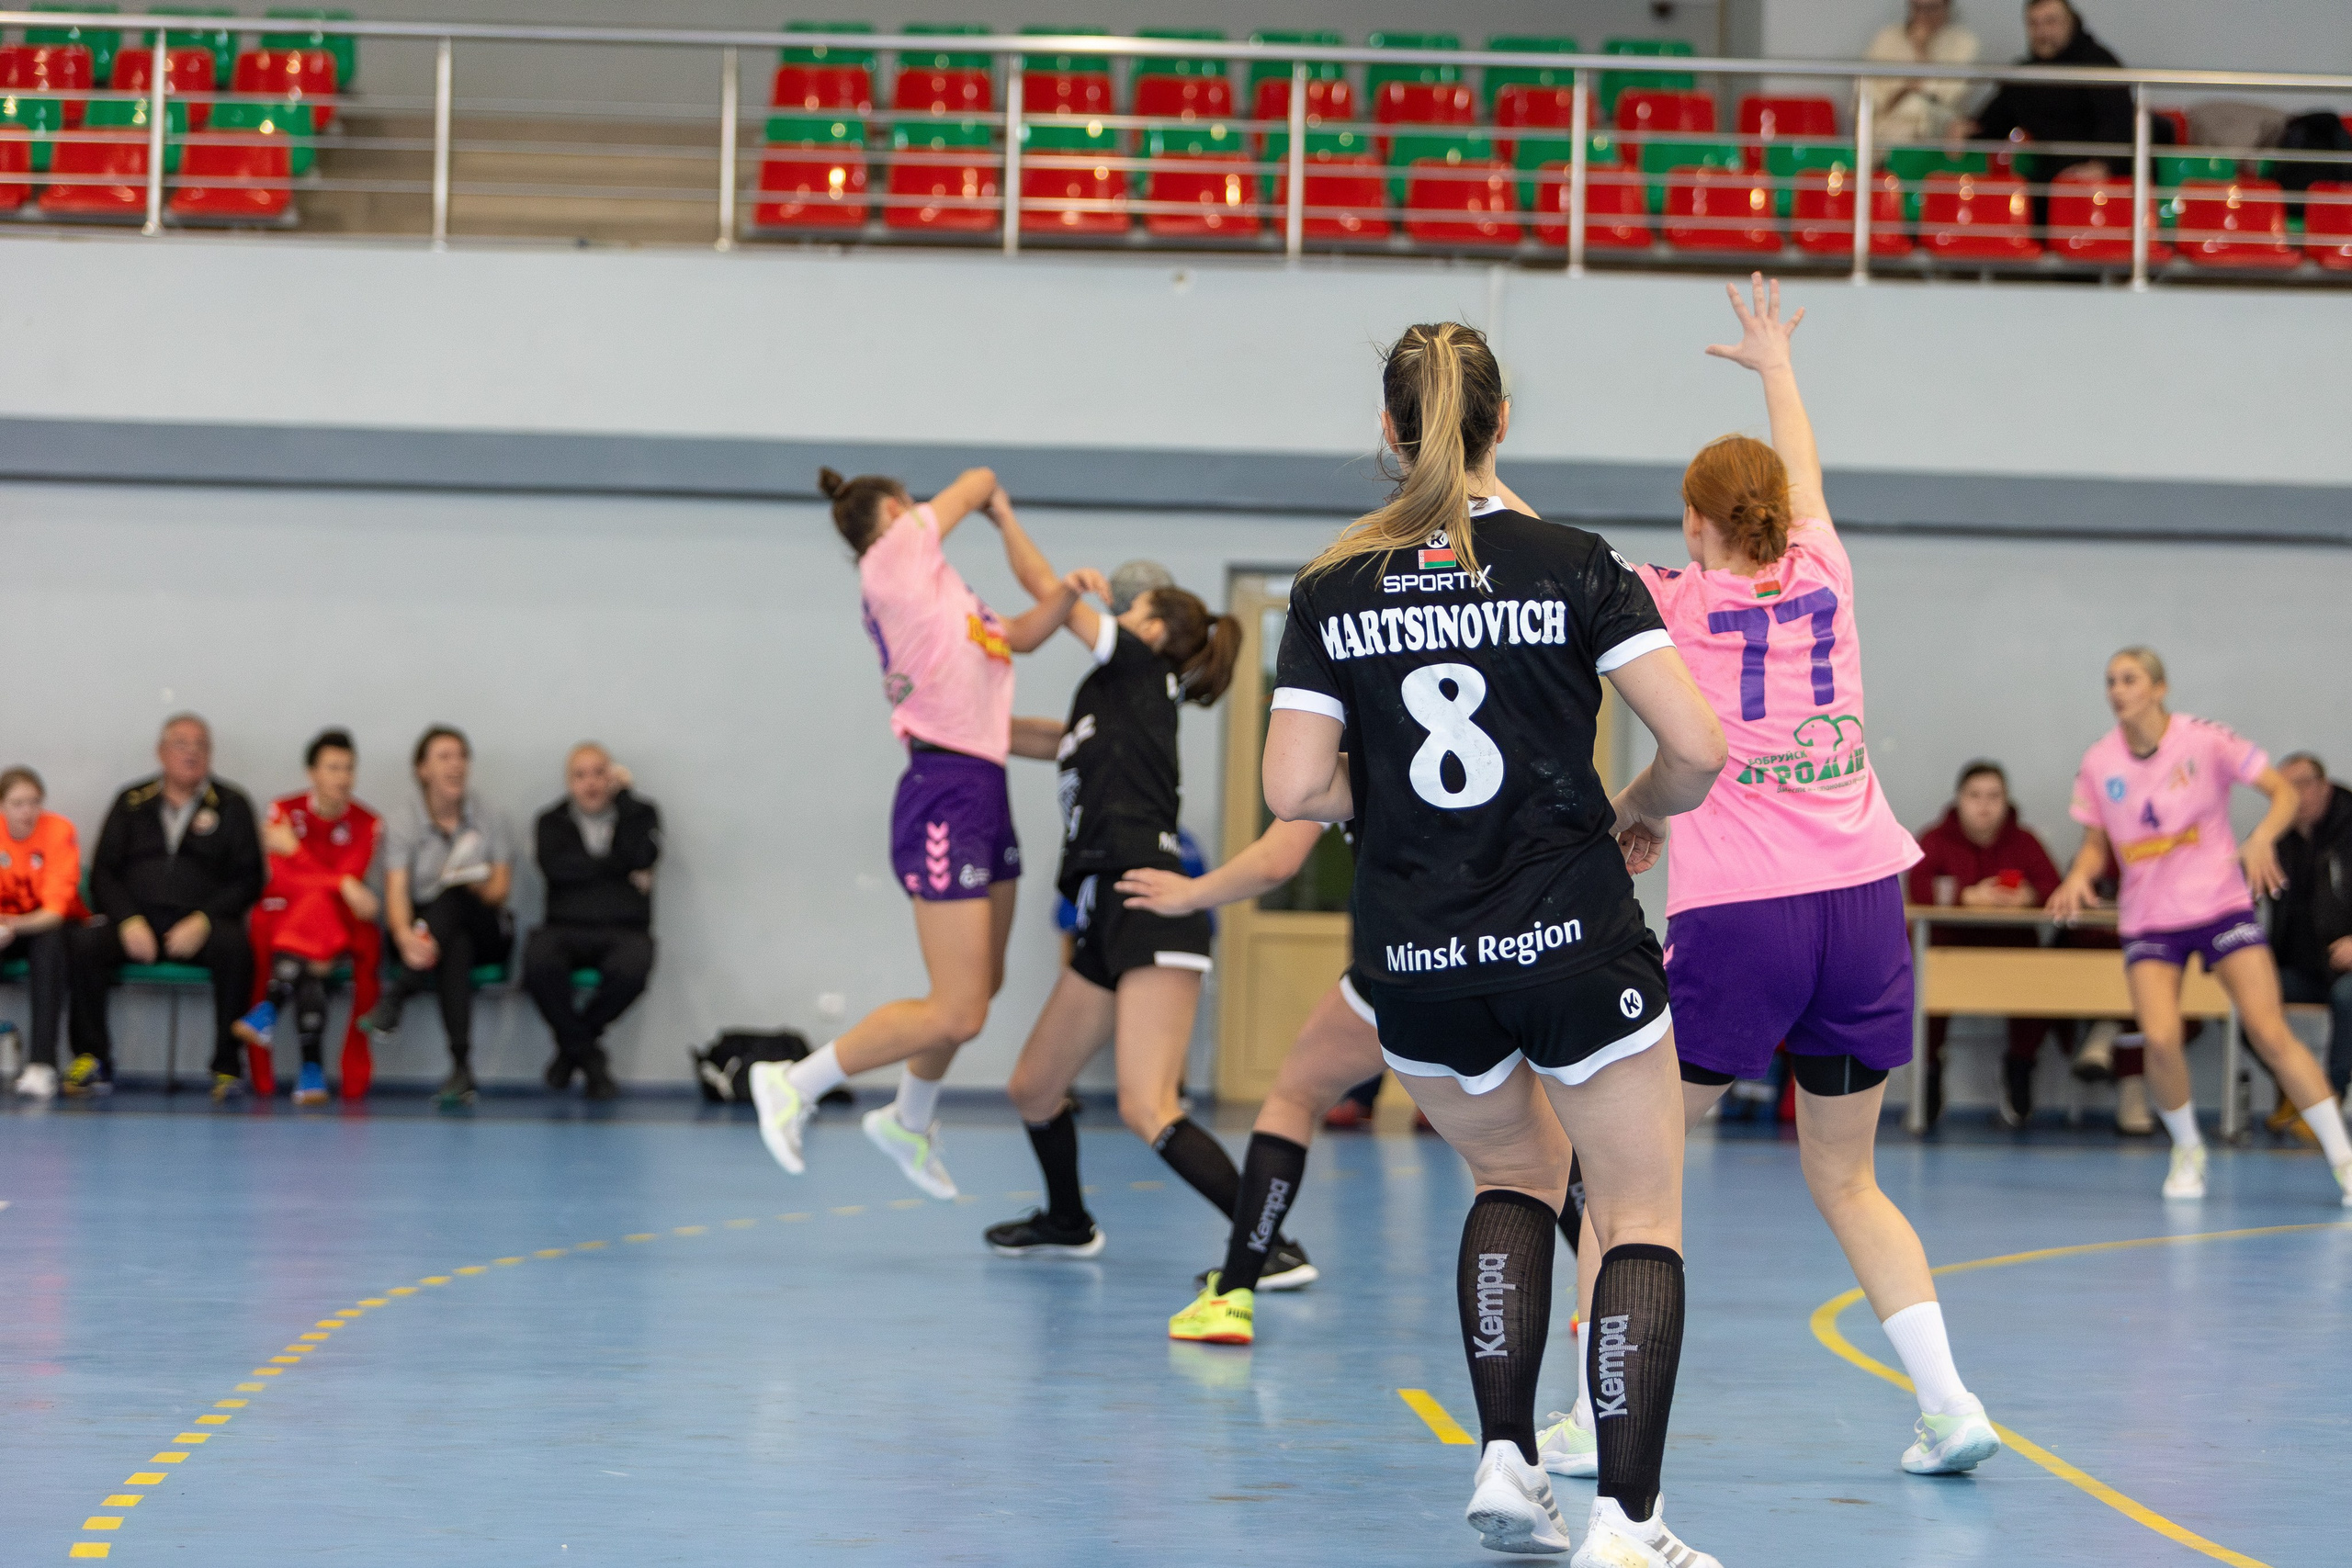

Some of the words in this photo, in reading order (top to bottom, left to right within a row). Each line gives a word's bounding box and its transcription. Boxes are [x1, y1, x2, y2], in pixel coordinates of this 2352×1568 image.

[1384, 564, 1493, 593] SPORTIX
[1708, 586, 1838, 721] 77
[1401, 663, 1504, 808] 8
[1385, 937, 1467, 972] Minsk
[1477, 919, 1582, 964] Region
[1247, 1178, 1291, 1254] Kempa
[1473, 1253, 1516, 1359] Kempa
[1596, 1314, 1639, 1418] Kempa
